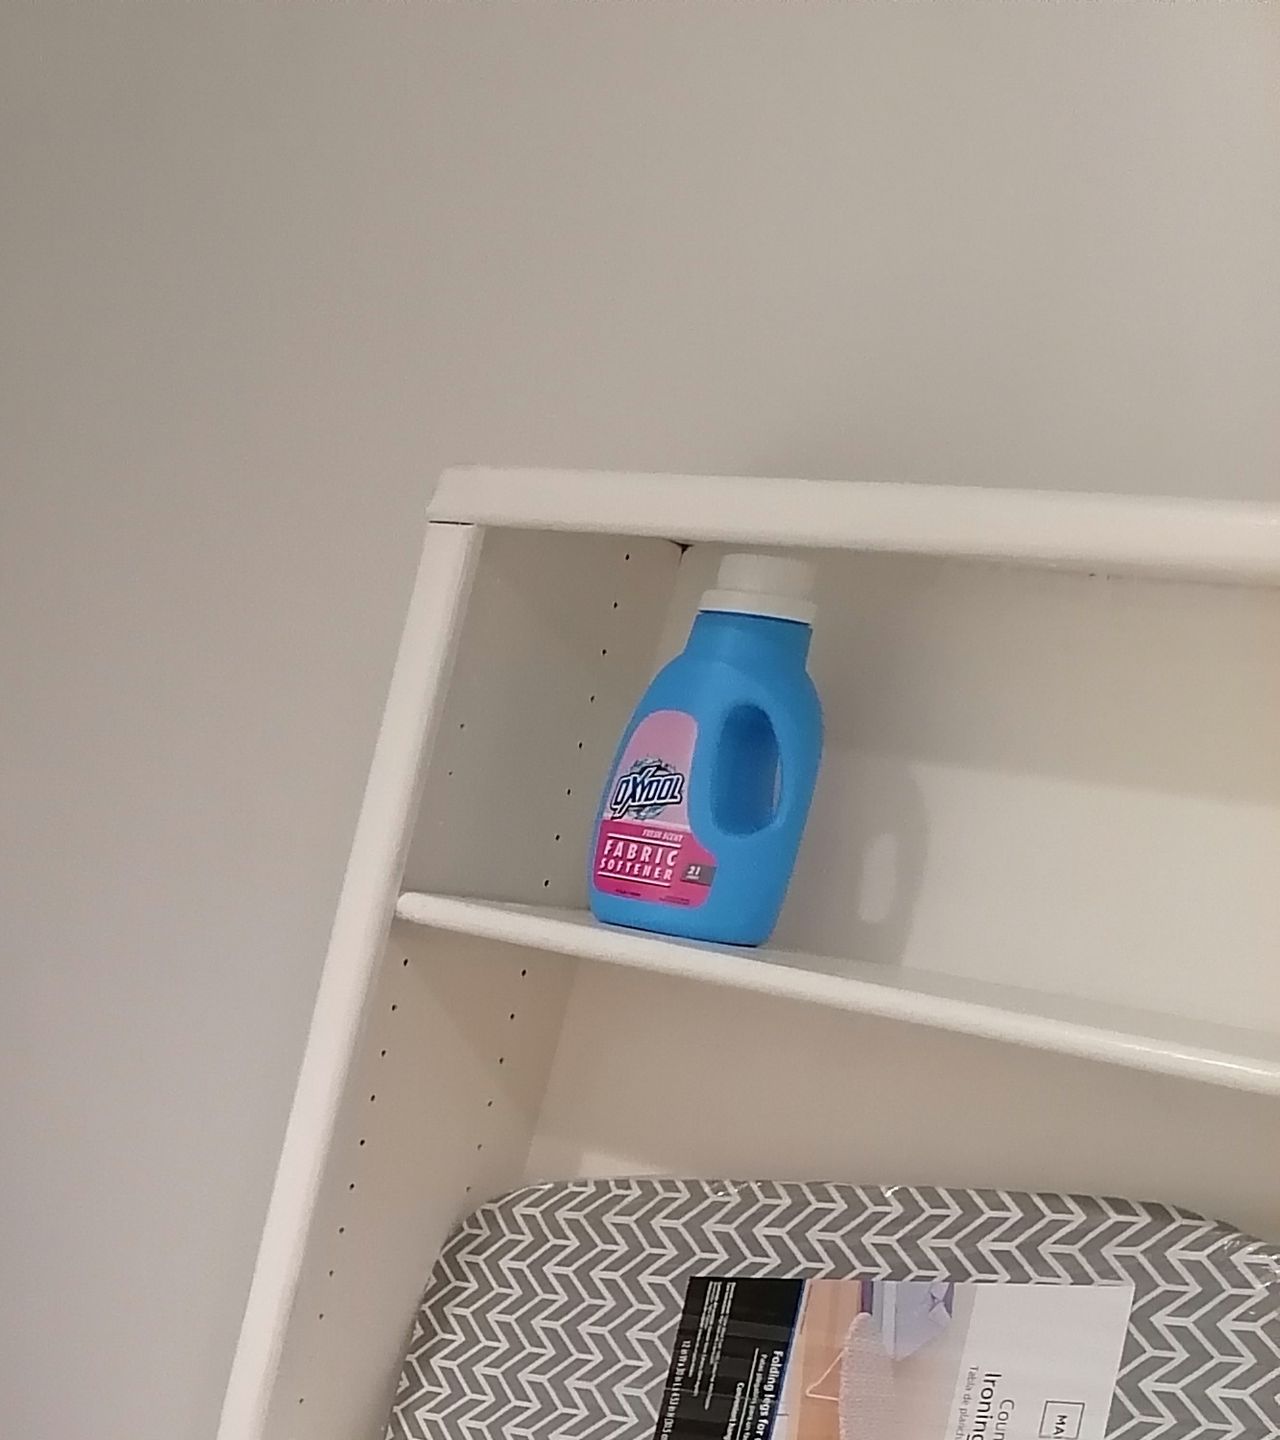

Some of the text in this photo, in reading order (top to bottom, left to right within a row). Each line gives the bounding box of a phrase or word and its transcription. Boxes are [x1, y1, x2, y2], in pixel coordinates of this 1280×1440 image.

[603, 838, 680, 867] FABRIC
[600, 857, 673, 881] SOFTENER
[687, 865, 701, 876] 21
[682, 1339, 690, 1348] 12
[764, 1350, 783, 1391] Folding
[964, 1366, 979, 1391] Tabla
[758, 1394, 772, 1416] legs
[962, 1393, 972, 1406] de
[755, 1418, 768, 1435] for
